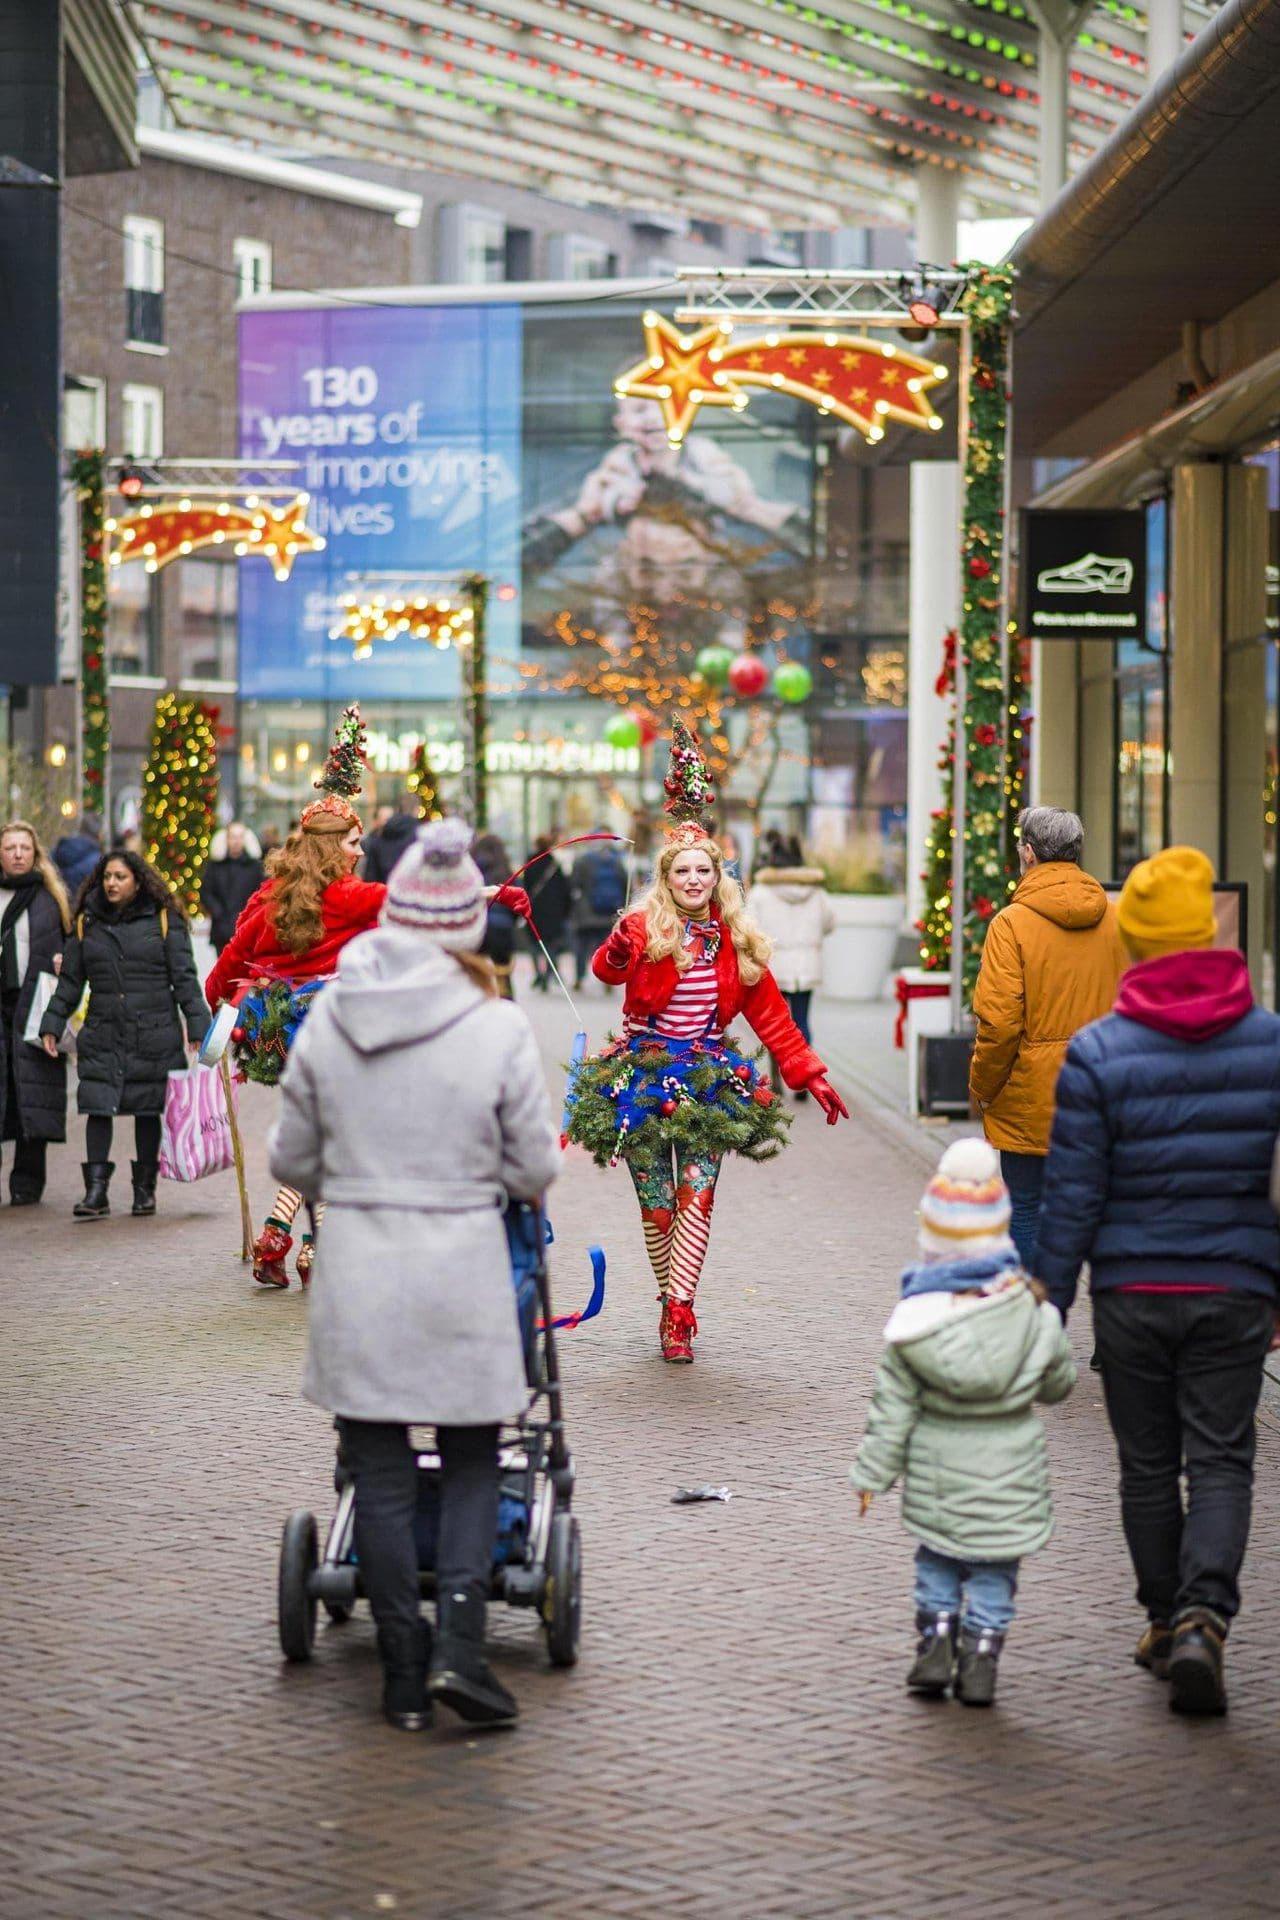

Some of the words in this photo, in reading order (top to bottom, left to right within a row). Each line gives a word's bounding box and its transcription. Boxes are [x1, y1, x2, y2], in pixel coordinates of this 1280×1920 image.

[303, 365, 378, 407] 130
[259, 412, 376, 457] years
[380, 399, 424, 444] of
[306, 449, 503, 496] improving
[307, 497, 396, 536] lives
[200, 1111, 231, 1135] MONK
